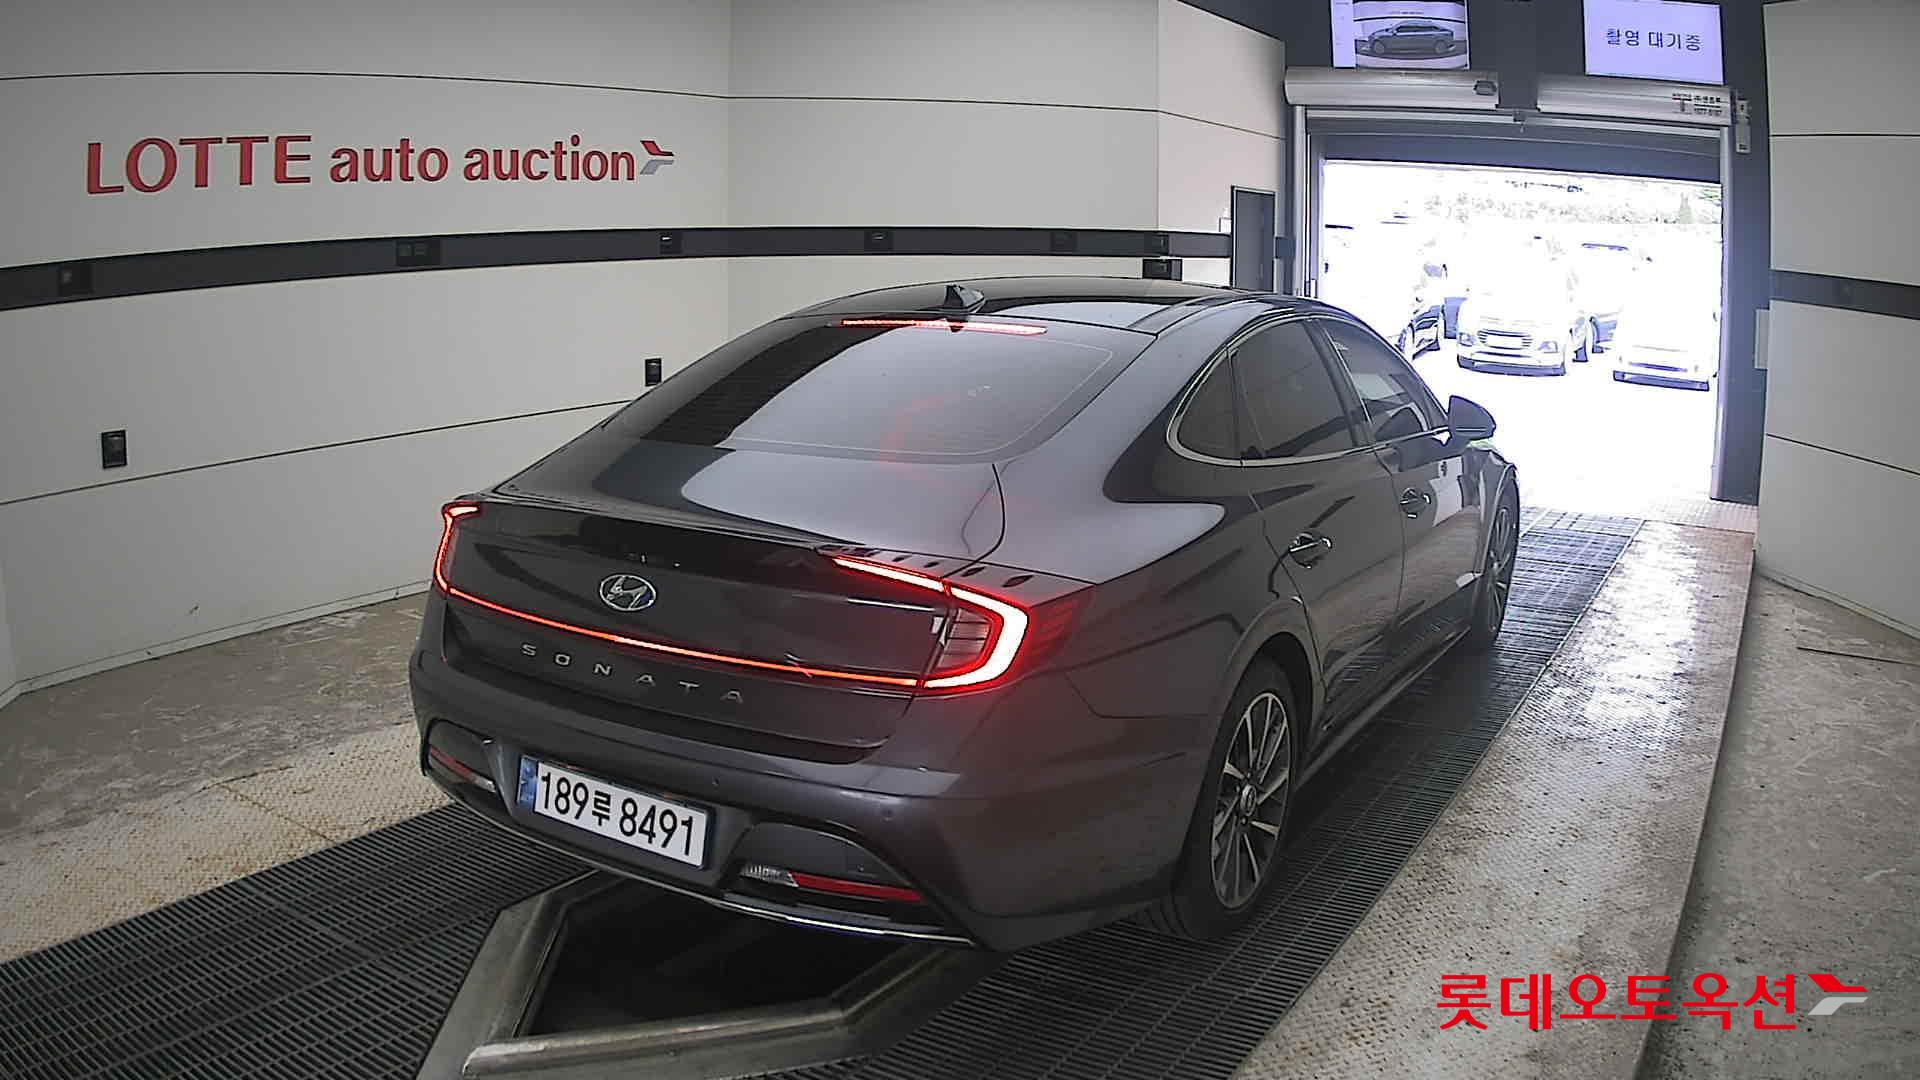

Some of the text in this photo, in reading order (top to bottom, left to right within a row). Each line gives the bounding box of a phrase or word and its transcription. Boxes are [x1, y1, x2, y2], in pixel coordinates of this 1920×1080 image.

[1648, 31, 1701, 52] 대기중
[87, 134, 636, 195] LOTTE auto auction
[521, 643, 743, 704] SONATA
[619, 798, 694, 856] 8491
